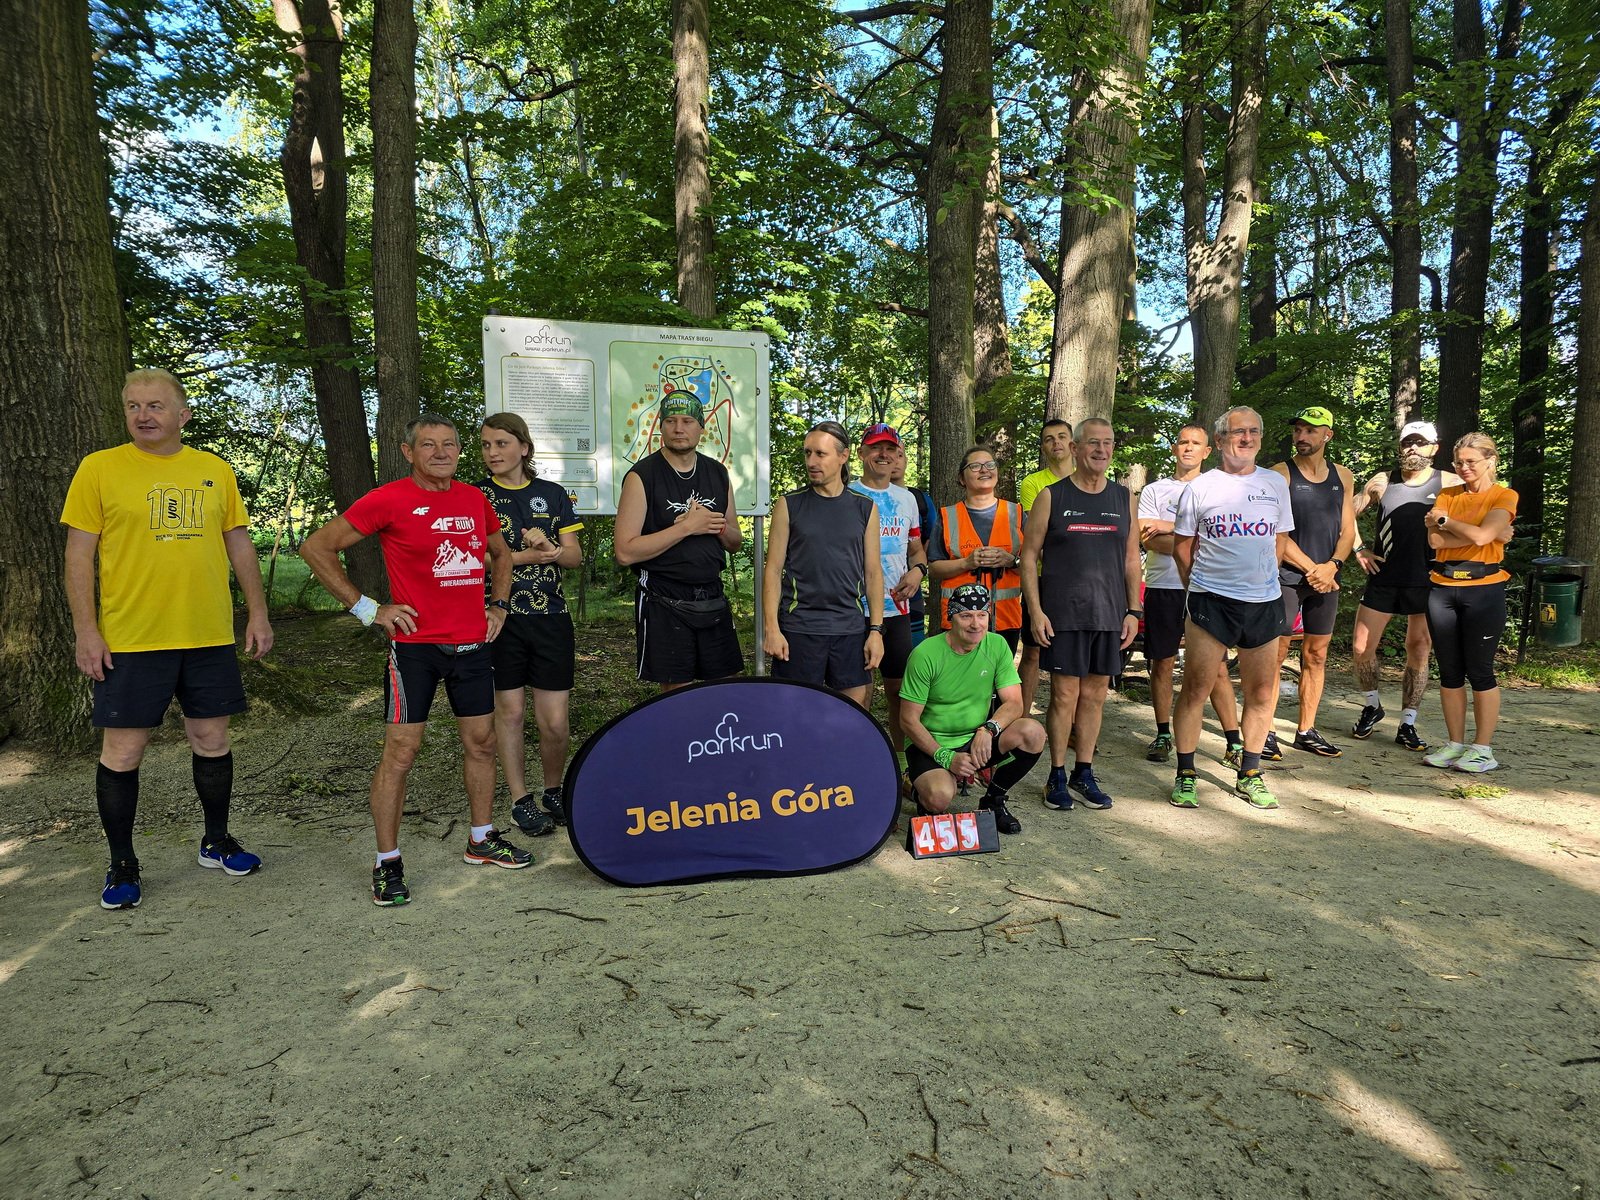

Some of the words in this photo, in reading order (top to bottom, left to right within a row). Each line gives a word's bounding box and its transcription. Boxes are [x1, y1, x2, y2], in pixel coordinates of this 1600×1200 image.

[525, 325, 571, 345] parkrun
[147, 488, 204, 529] 10K
[412, 506, 430, 515] 4F
[431, 517, 454, 531] 4F
[455, 519, 471, 530] RUN
[1204, 514, 1225, 525] RUN
[1229, 513, 1242, 522] IN
[880, 526, 900, 536] AM
[688, 712, 783, 763] parkrun
[625, 791, 761, 836] Jelenia
[771, 783, 855, 817] Góra
[919, 819, 976, 852] 455
